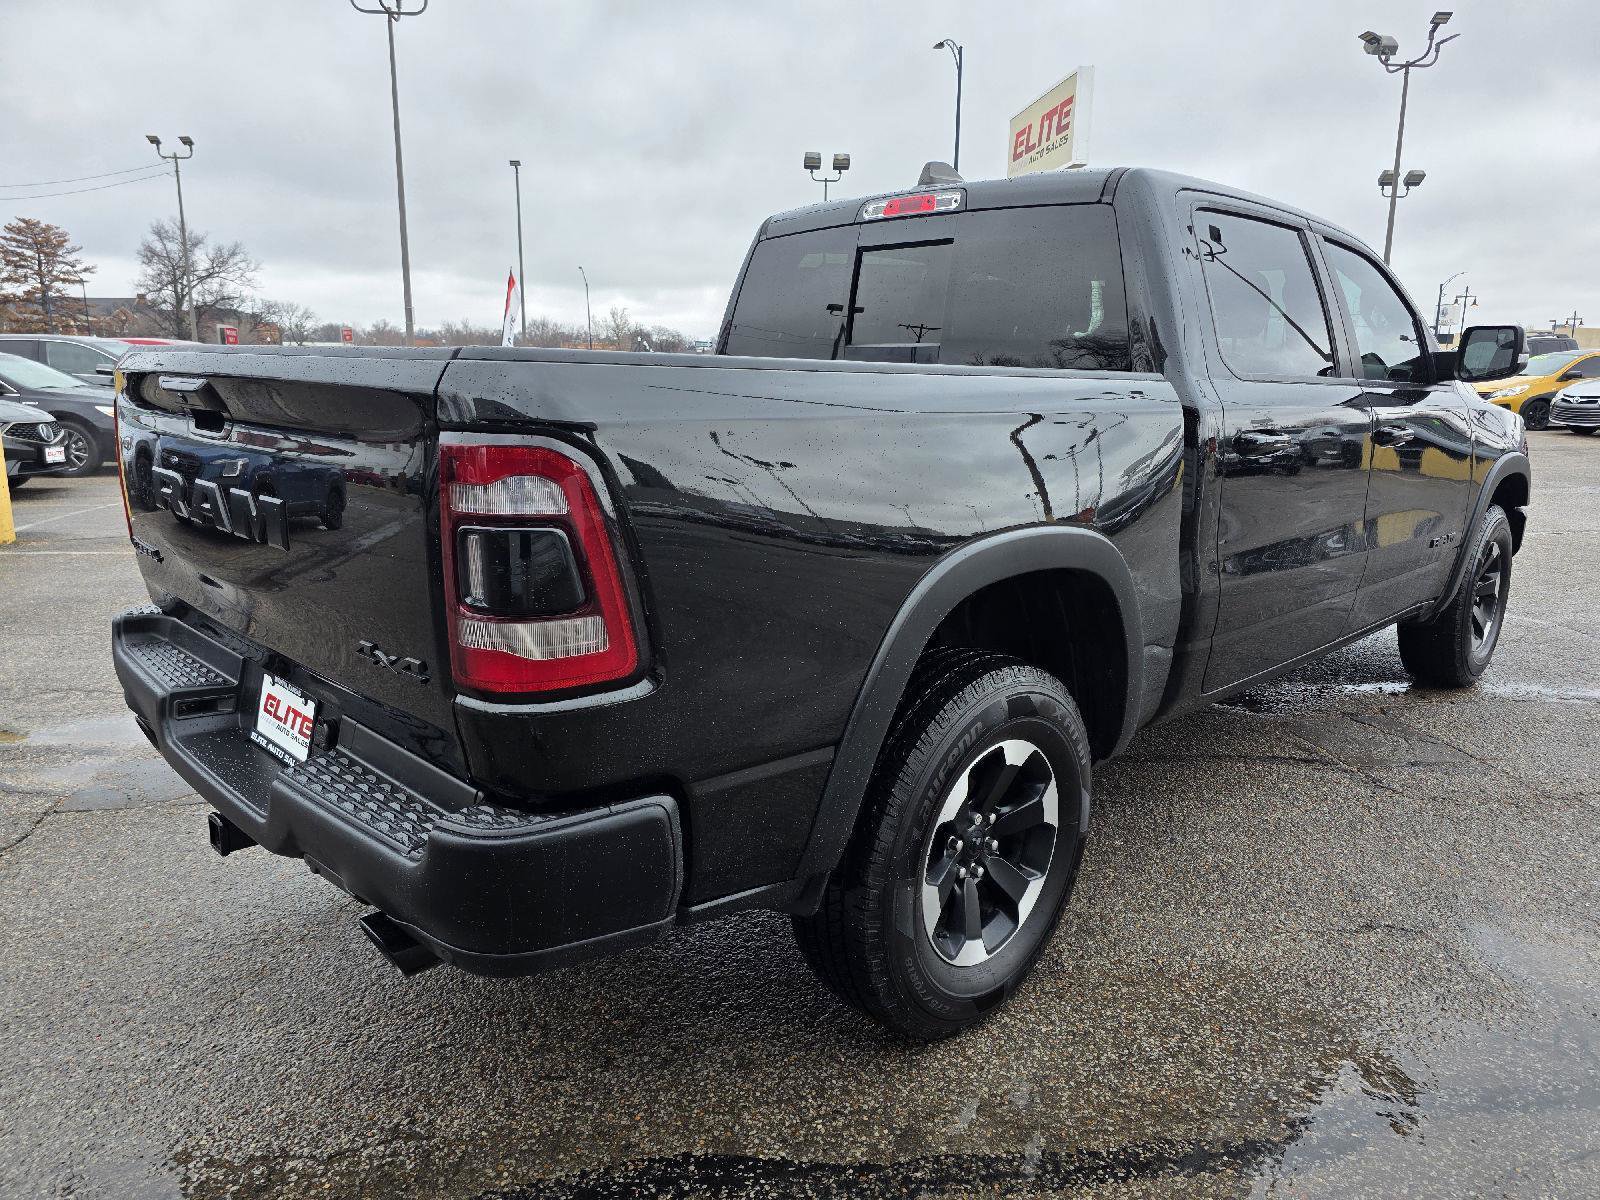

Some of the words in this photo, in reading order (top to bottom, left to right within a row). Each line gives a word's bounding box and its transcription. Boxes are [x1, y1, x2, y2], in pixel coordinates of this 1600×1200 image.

[1012, 94, 1075, 163] ELITE
[1028, 147, 1045, 164] AUTO
[1045, 134, 1069, 155] SALES
[151, 465, 290, 552] RAM
[263, 692, 314, 740] ELITE
[250, 731, 267, 747] ELITE
[267, 743, 285, 759] AUTO
[275, 723, 291, 737] AUTO
[290, 733, 309, 749] SALES
